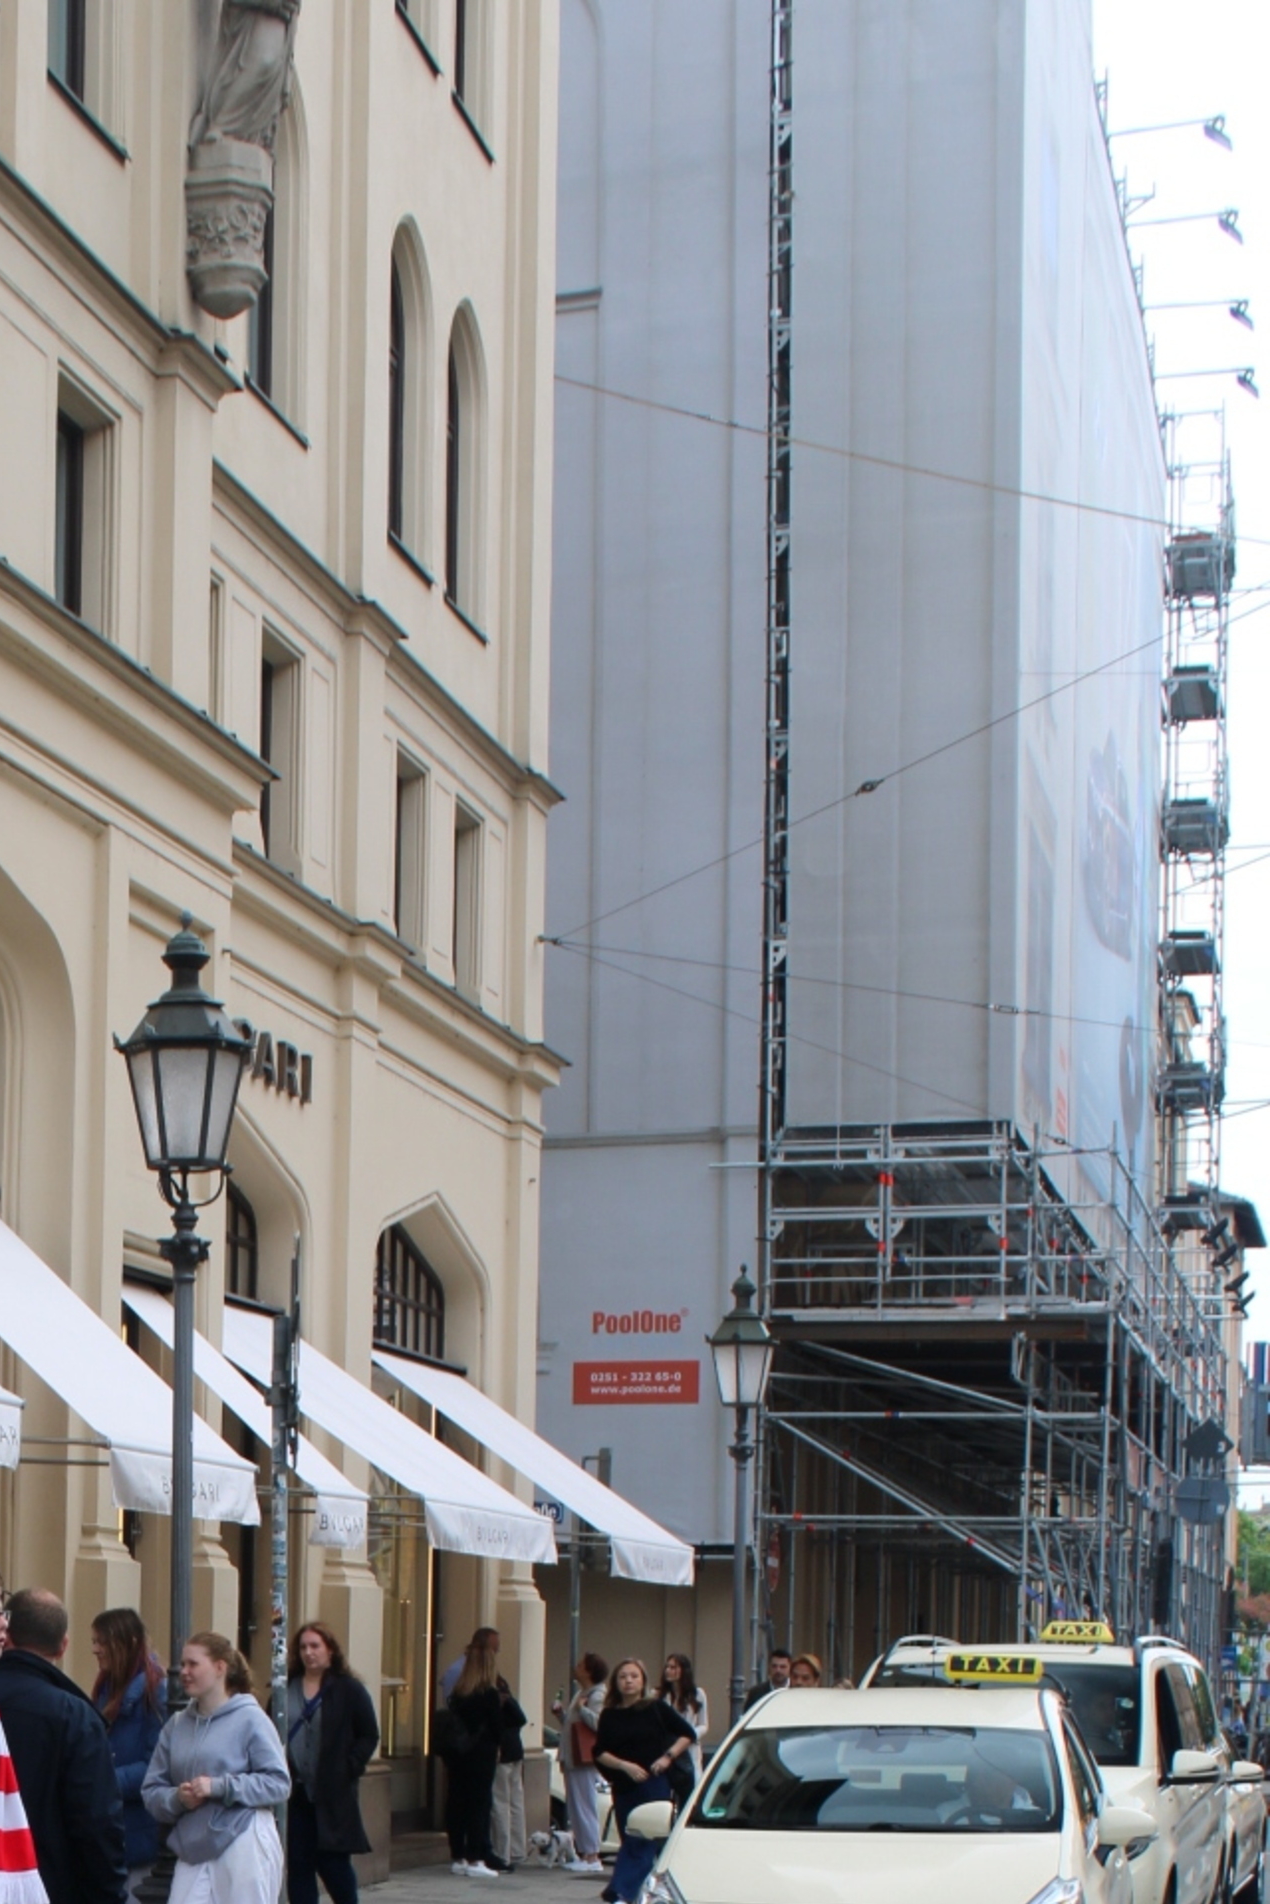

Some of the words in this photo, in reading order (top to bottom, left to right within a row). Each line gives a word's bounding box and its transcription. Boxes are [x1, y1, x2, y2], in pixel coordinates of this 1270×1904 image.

[591, 1372, 618, 1382] 0251
[630, 1372, 652, 1382] 322
[655, 1372, 681, 1382] 65-0
[590, 1384, 681, 1395] www.poolone.de
[1053, 1625, 1102, 1636] TAXI
[960, 1656, 1025, 1674] TAXI
